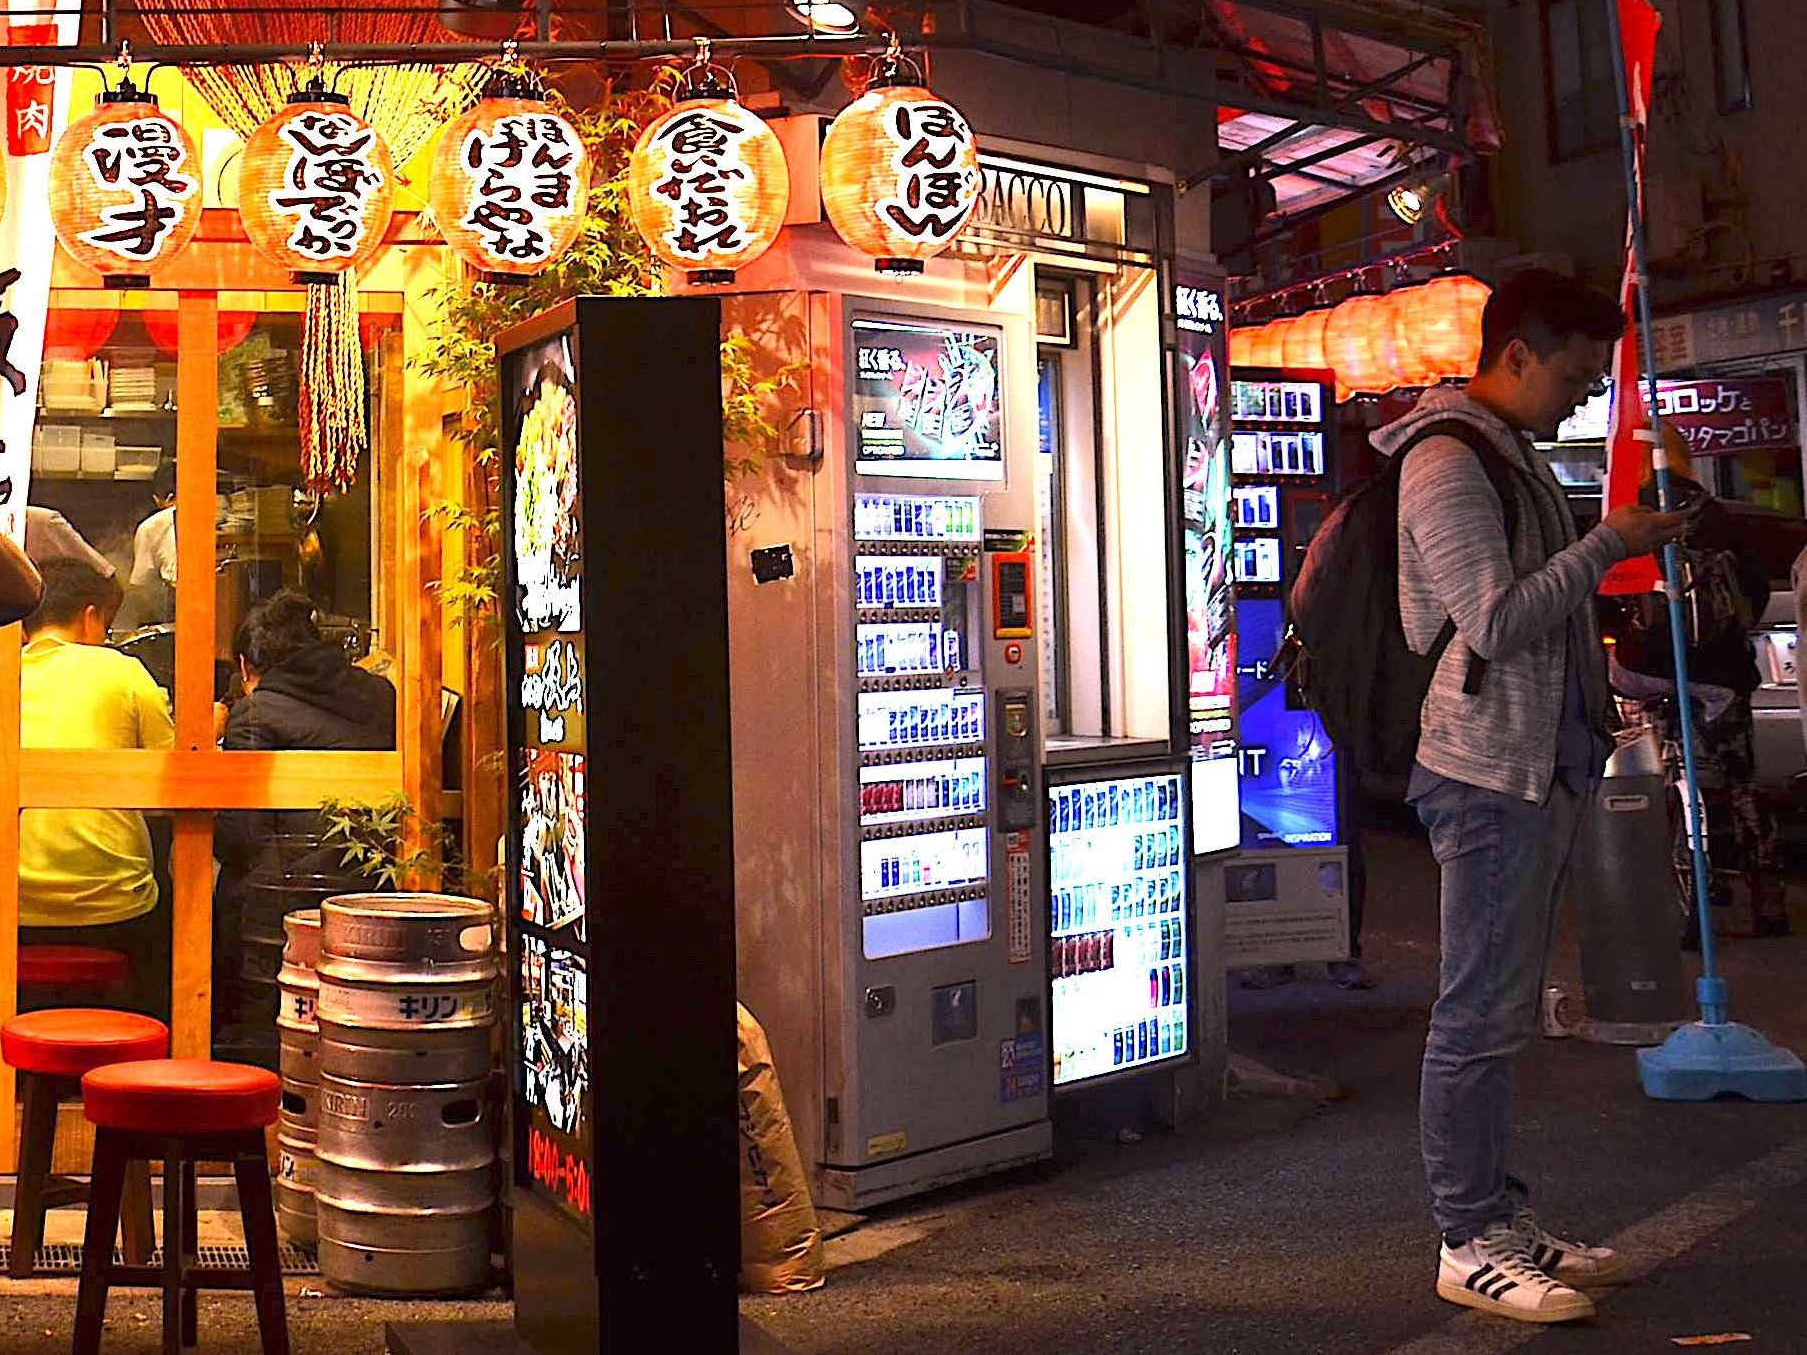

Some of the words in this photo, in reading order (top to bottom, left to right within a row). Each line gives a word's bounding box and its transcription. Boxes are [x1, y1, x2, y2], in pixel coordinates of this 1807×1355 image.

[91, 123, 188, 254] 漫才
[657, 114, 744, 253] 食いだおれ
[400, 995, 457, 1019] キリン
